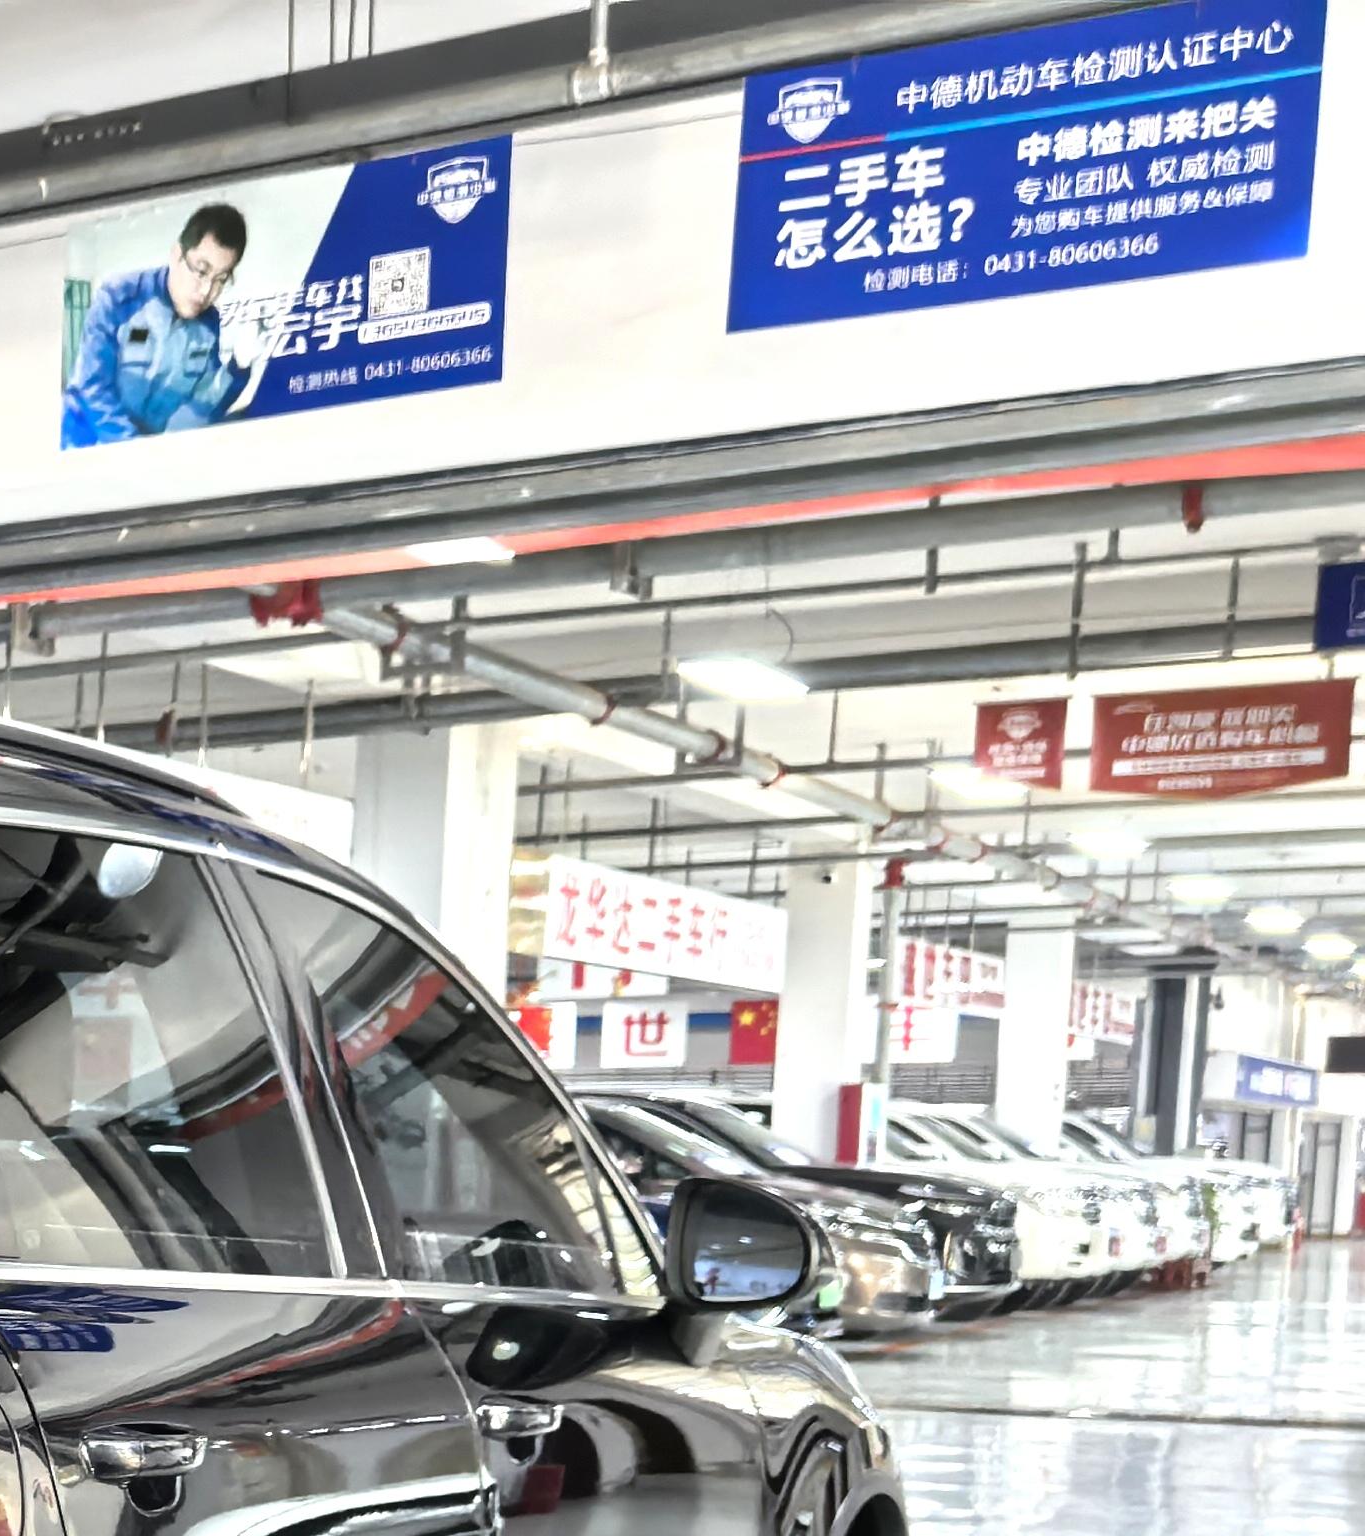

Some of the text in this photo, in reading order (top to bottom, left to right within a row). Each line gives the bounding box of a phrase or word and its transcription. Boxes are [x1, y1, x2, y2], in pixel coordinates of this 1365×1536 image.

[895, 19, 1294, 114] 中德机动车检测认证中心
[1015, 96, 1279, 168] 中德检测来把关
[776, 147, 948, 213] 二手车
[1013, 138, 1277, 206] 专业团队 权威检测
[983, 235, 1159, 279] 0431-80606366
